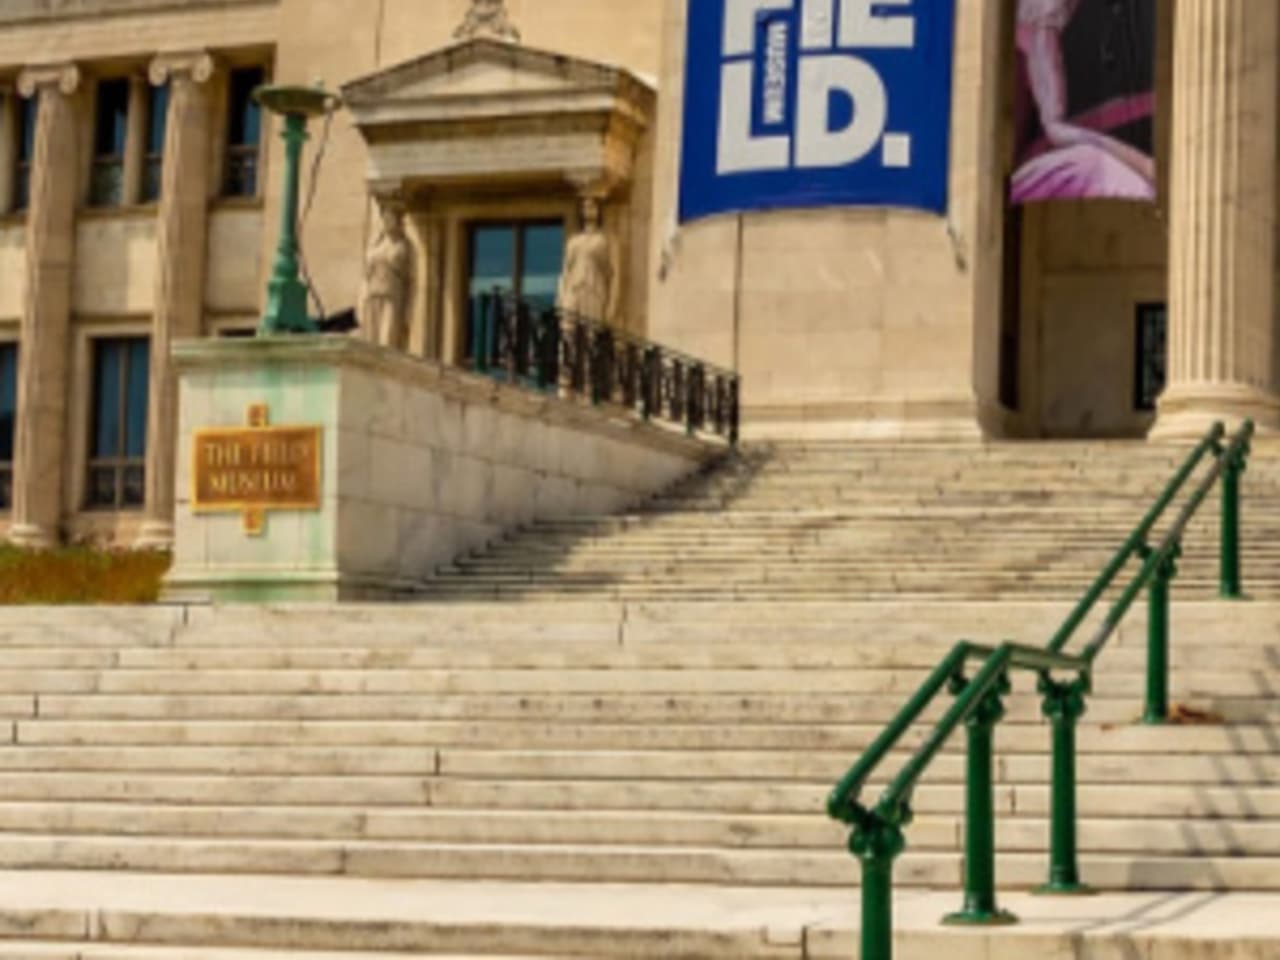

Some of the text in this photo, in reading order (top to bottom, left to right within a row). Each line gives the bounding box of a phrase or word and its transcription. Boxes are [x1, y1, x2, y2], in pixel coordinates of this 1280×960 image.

[205, 440, 311, 465] THE FIELD
[209, 469, 298, 494] MUSEUM
